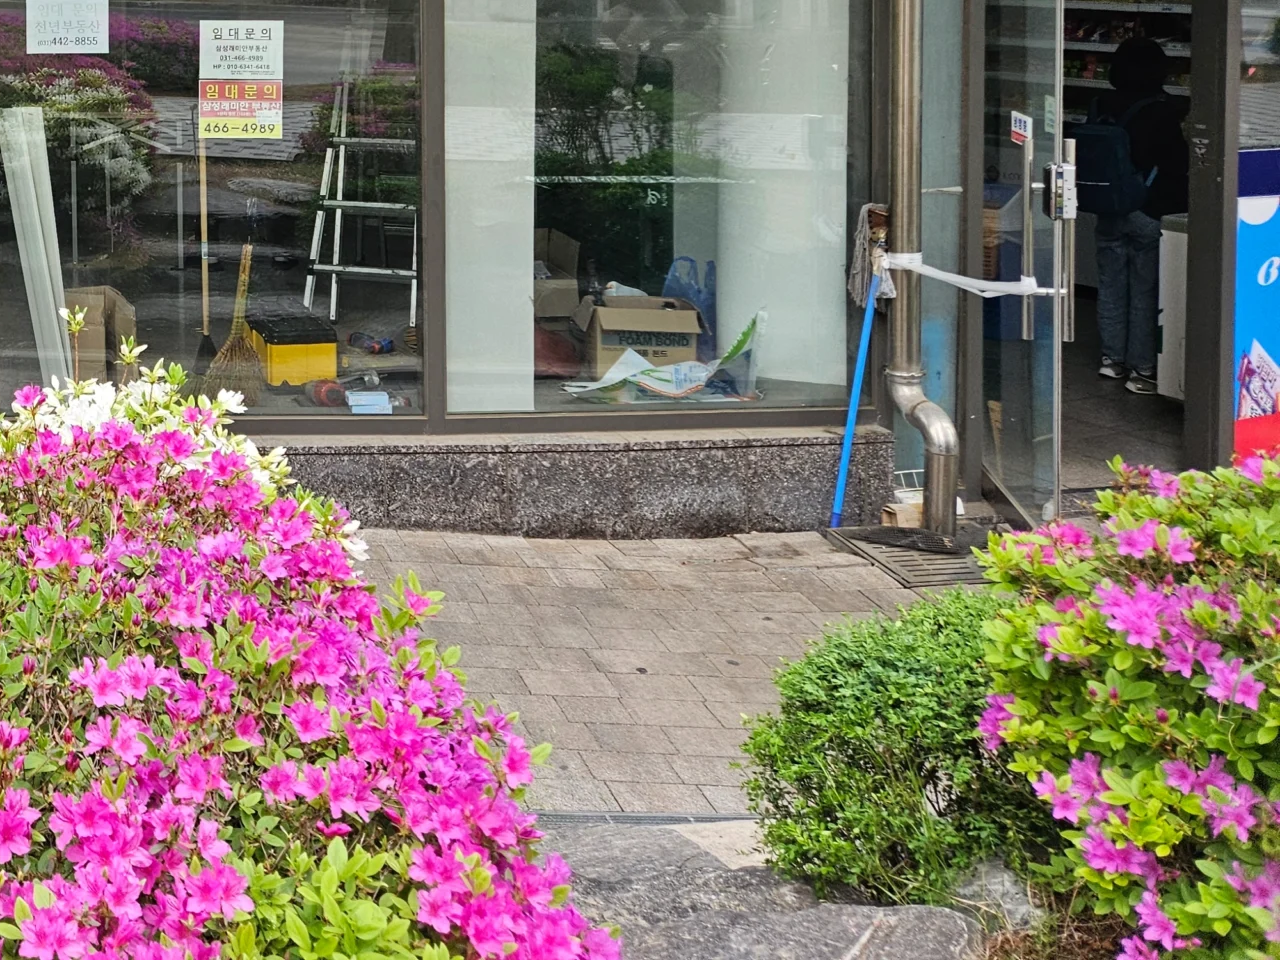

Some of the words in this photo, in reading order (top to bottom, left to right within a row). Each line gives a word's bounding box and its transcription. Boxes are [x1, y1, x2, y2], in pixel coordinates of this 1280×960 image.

[35, 20, 100, 34] 천년부동산
[204, 123, 275, 134] 466-4989
[620, 336, 653, 346] FOAM
[656, 338, 689, 347] BOND
